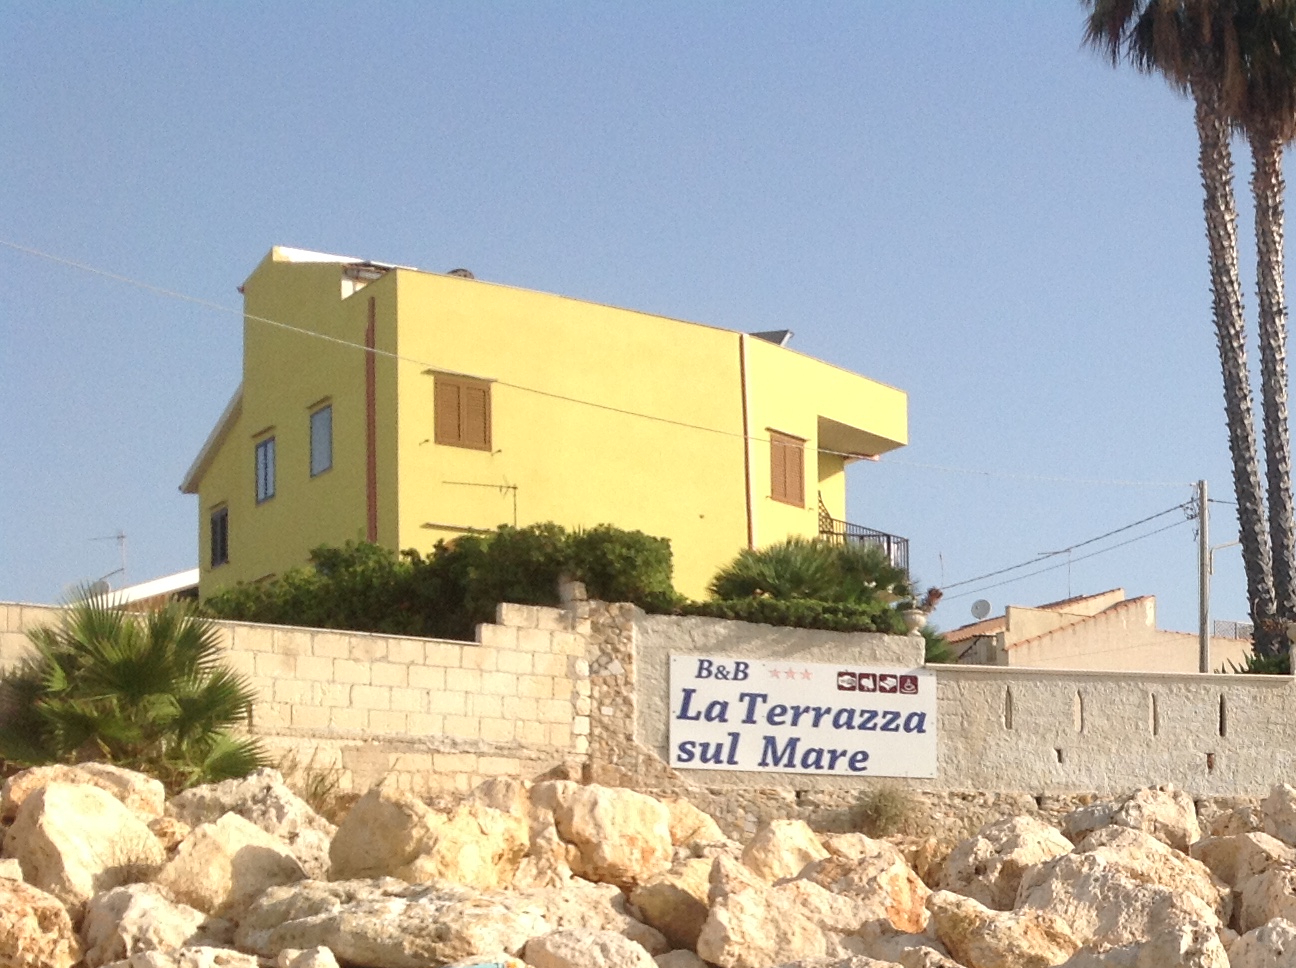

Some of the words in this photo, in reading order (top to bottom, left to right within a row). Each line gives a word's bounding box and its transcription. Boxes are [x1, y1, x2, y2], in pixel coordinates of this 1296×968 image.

[695, 659, 750, 681] B&B
[676, 688, 729, 723] La
[739, 692, 927, 734] Terrazza
[677, 732, 740, 765] sul
[758, 735, 870, 772] Mare
